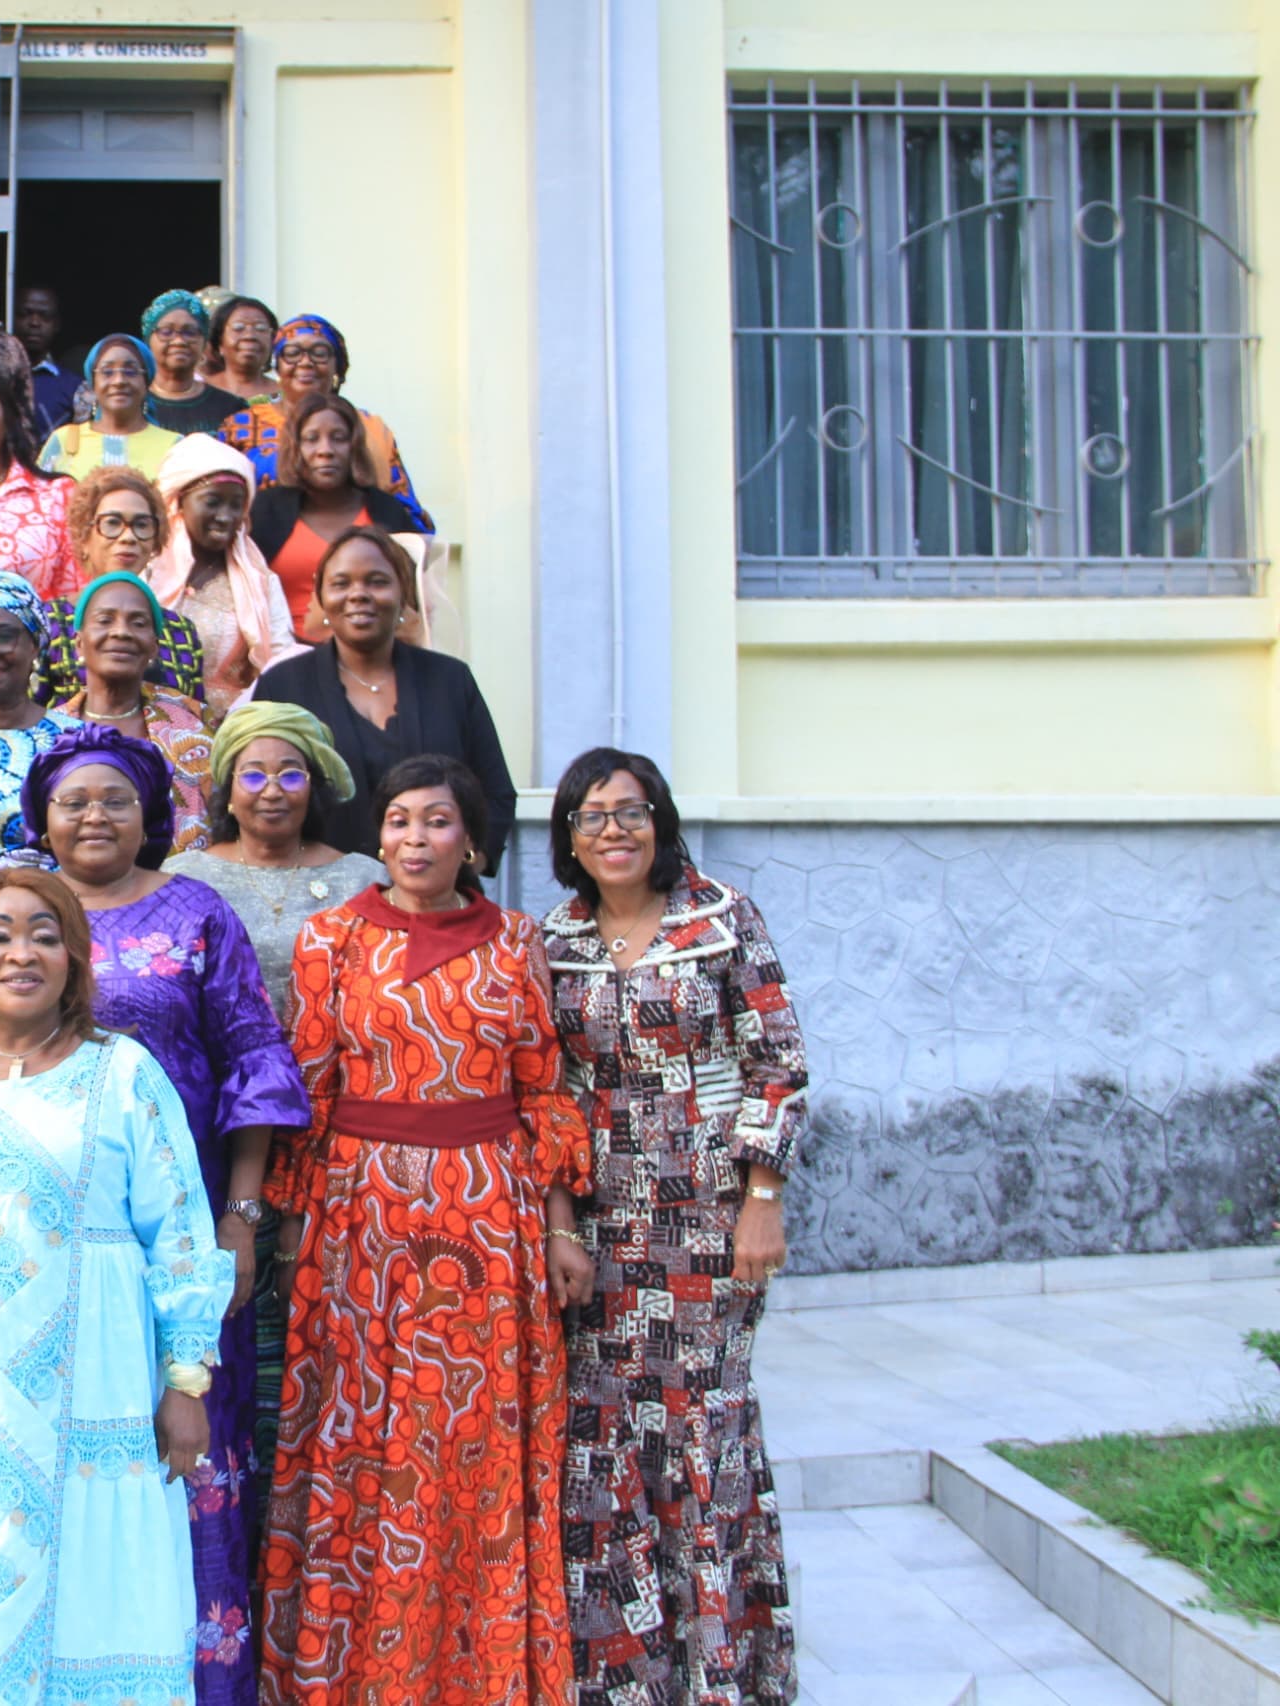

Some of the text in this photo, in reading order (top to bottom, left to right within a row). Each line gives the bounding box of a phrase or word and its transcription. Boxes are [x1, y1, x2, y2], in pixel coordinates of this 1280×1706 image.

[21, 41, 207, 57] ALLE DE CONFERENCES
